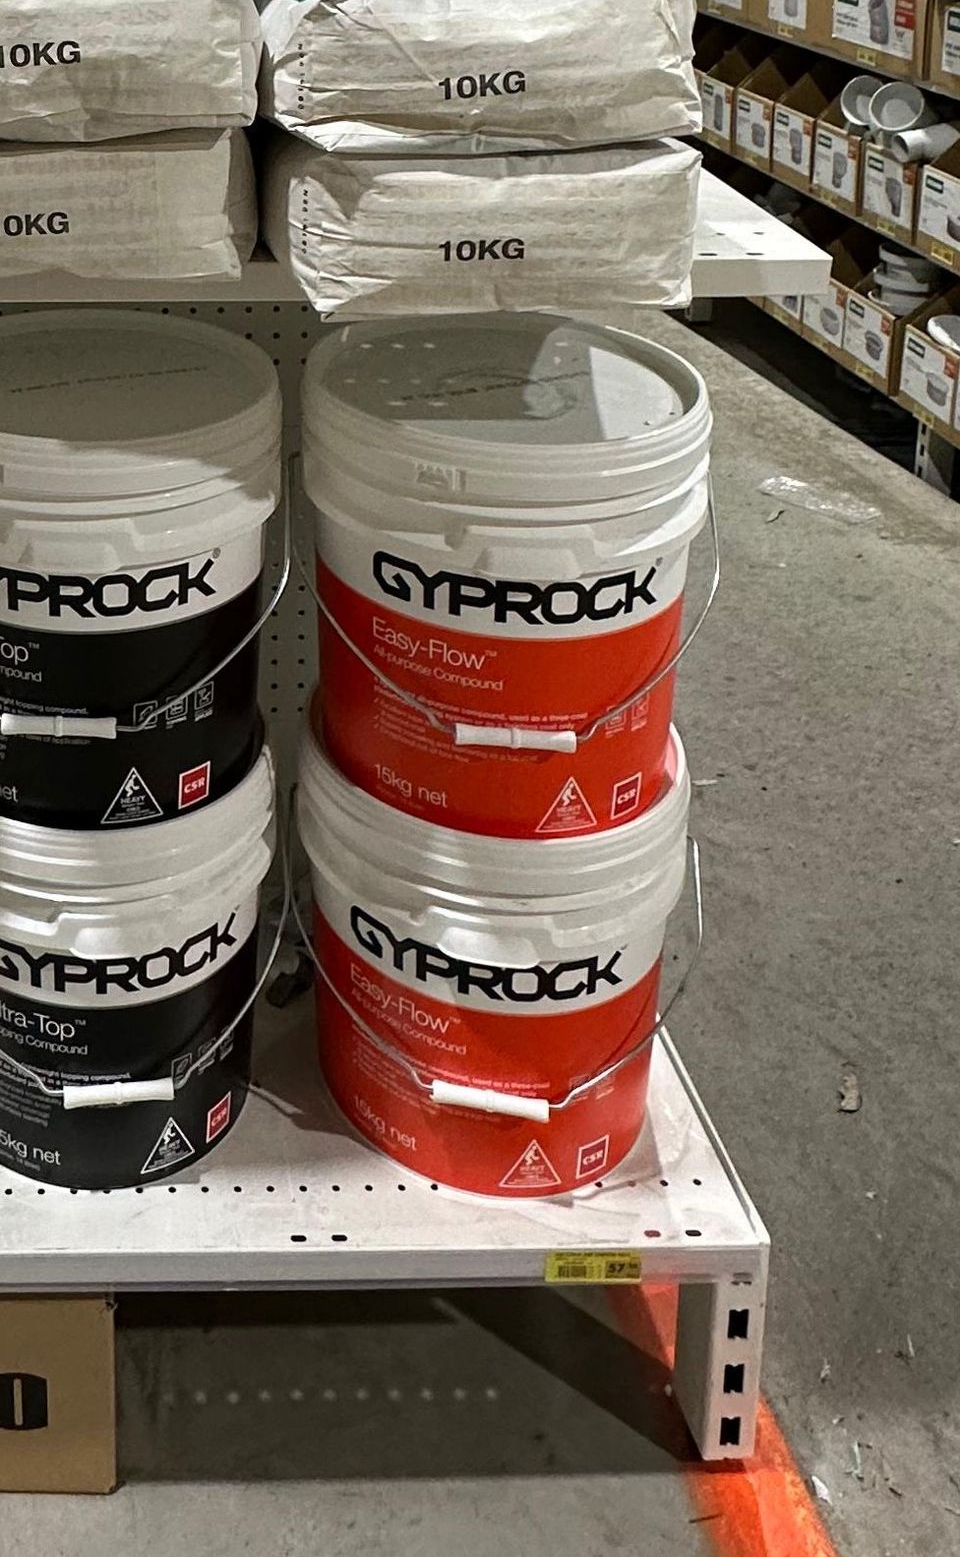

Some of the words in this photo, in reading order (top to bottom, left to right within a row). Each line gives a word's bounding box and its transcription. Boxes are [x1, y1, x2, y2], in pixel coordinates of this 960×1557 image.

[438, 69, 527, 101] 10KG
[438, 237, 525, 263] 10KG
[372, 550, 658, 626] GYPROCK
[372, 616, 486, 671] Easy-Flow
[374, 645, 432, 678] All-purpose
[432, 667, 504, 691] Compound
[184, 775, 206, 795] CSR
[375, 763, 412, 798] 15kg
[418, 787, 448, 809] net
[617, 787, 637, 805] CSR
[350, 904, 623, 1003] GYPROCK
[350, 963, 450, 1034] Easy-Flow
[24, 1033, 89, 1056] Compound
[402, 1023, 467, 1056] Compound
[390, 1127, 418, 1151] net
[32, 1145, 61, 1166] net
[581, 1148, 605, 1168] CSR
